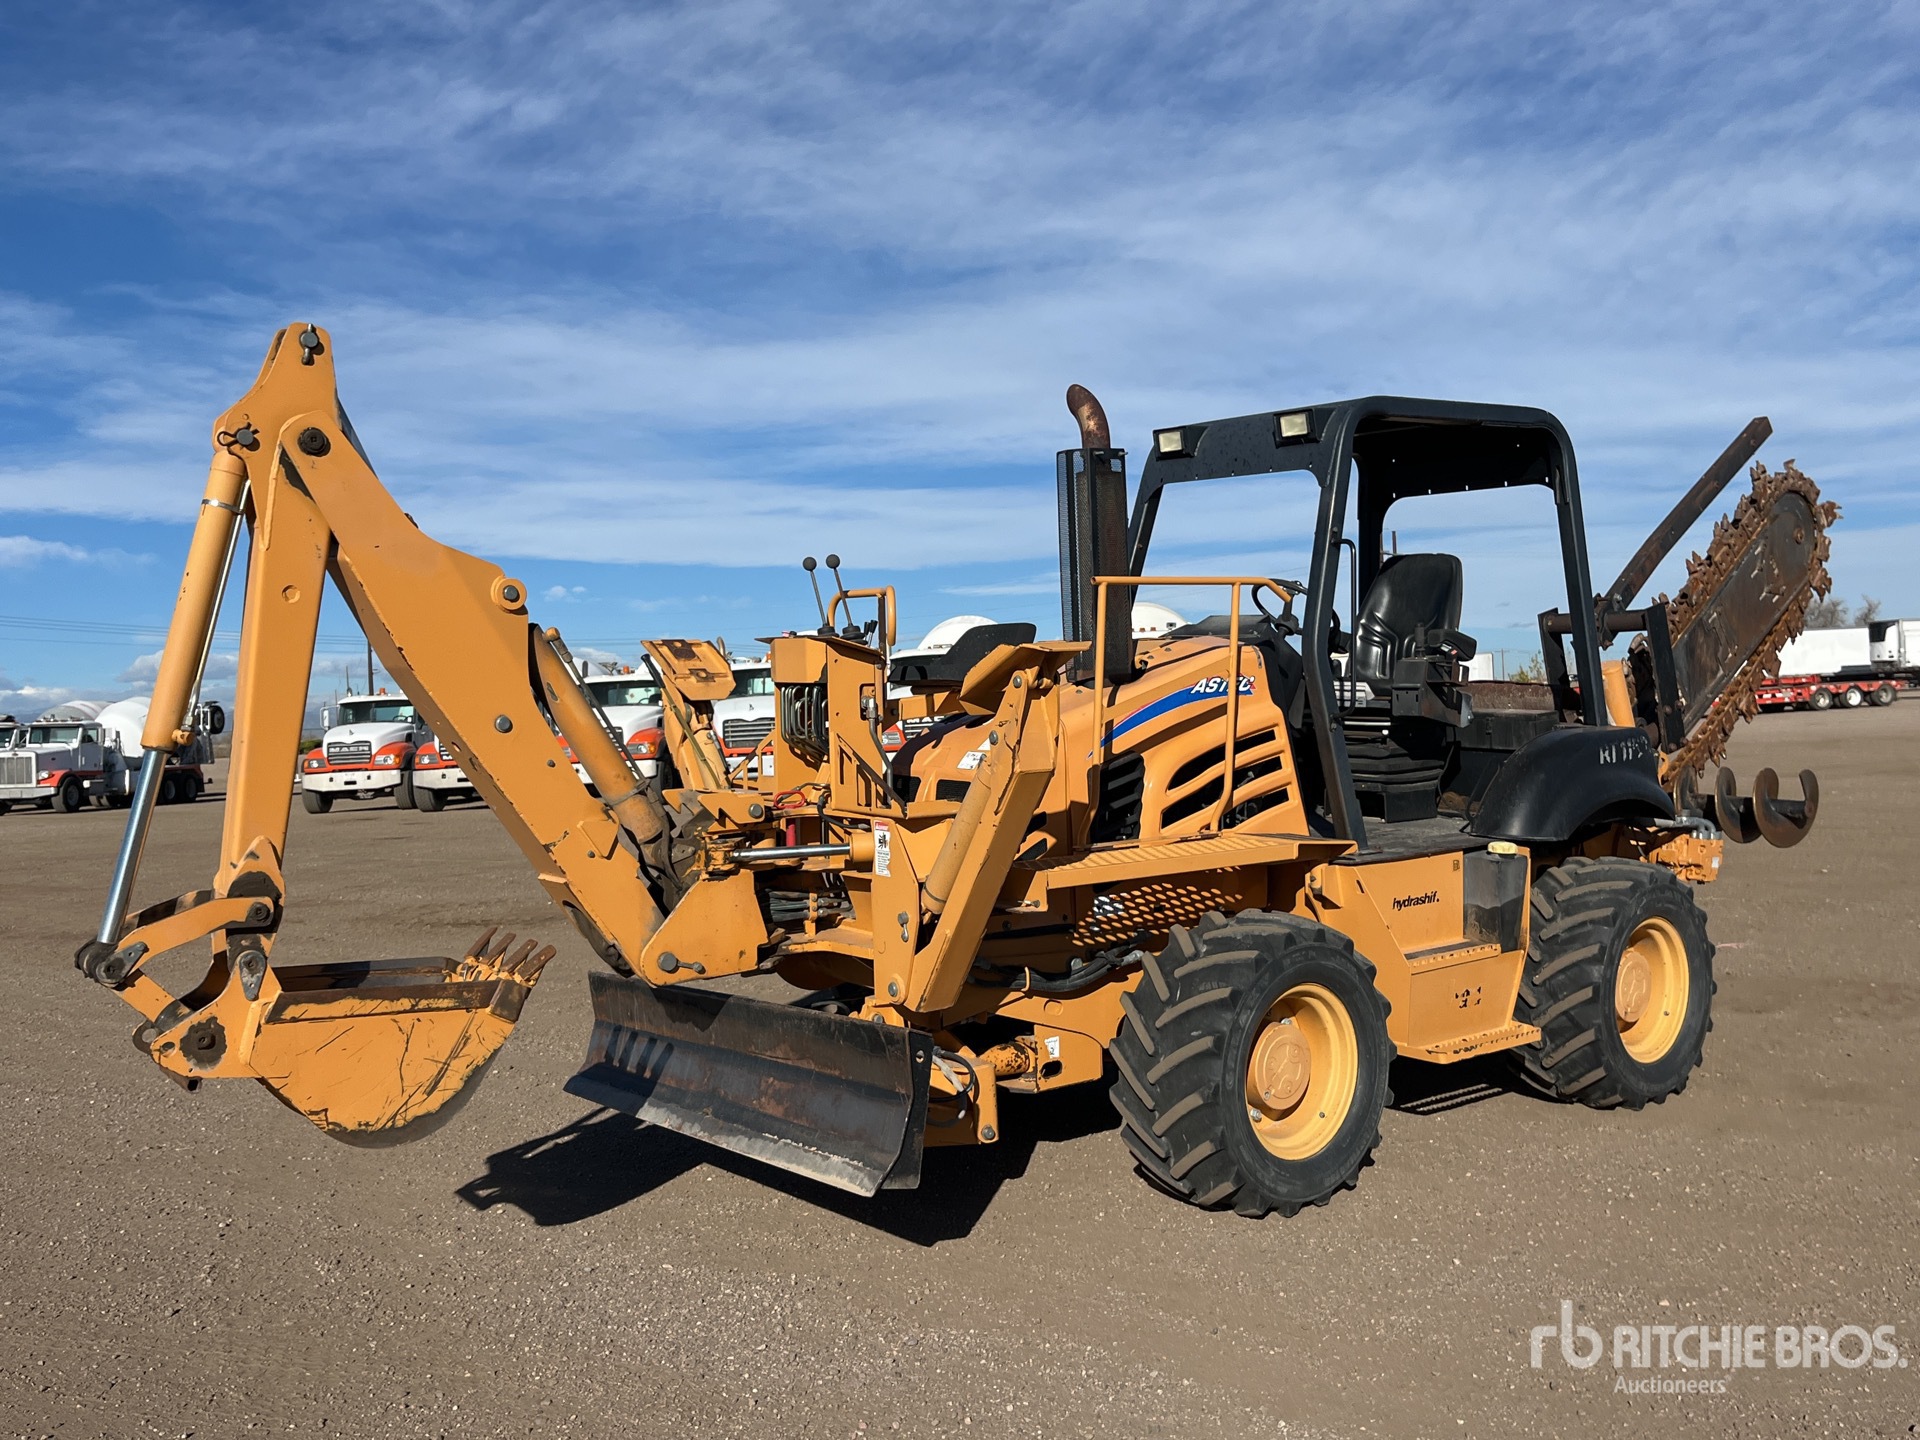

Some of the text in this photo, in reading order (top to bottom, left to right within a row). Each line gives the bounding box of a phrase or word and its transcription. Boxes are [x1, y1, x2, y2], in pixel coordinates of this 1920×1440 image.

[1190, 676, 1256, 694] ASTC
[906, 715, 945, 724] MAC
[1392, 891, 1440, 911] hydrashif
